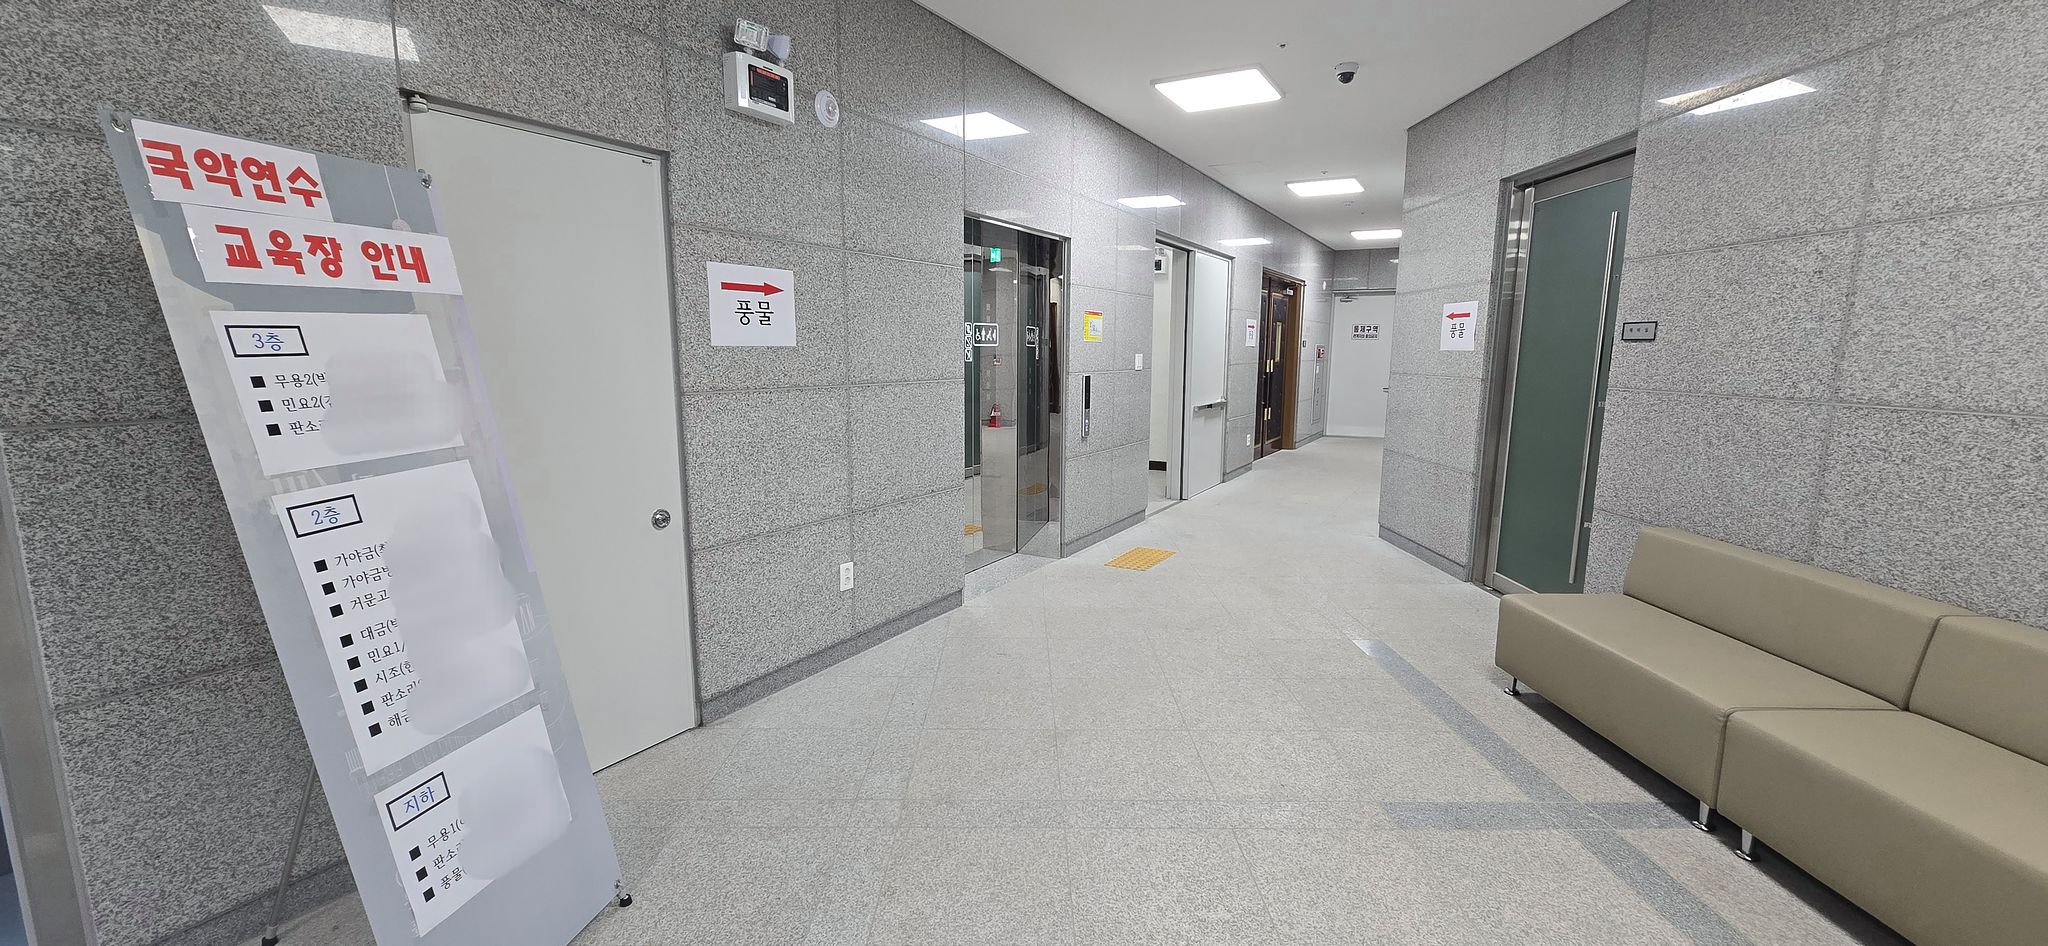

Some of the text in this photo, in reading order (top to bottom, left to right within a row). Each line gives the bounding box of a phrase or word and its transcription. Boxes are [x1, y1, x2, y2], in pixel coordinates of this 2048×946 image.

[139, 138, 323, 208] 국악연수
[215, 224, 431, 284] 교육장 안내
[734, 299, 775, 326] 풍물
[252, 332, 285, 352] 3층
[1449, 322, 1466, 339] 풍물
[311, 506, 341, 526] 2층
[403, 786, 435, 813] 지하
